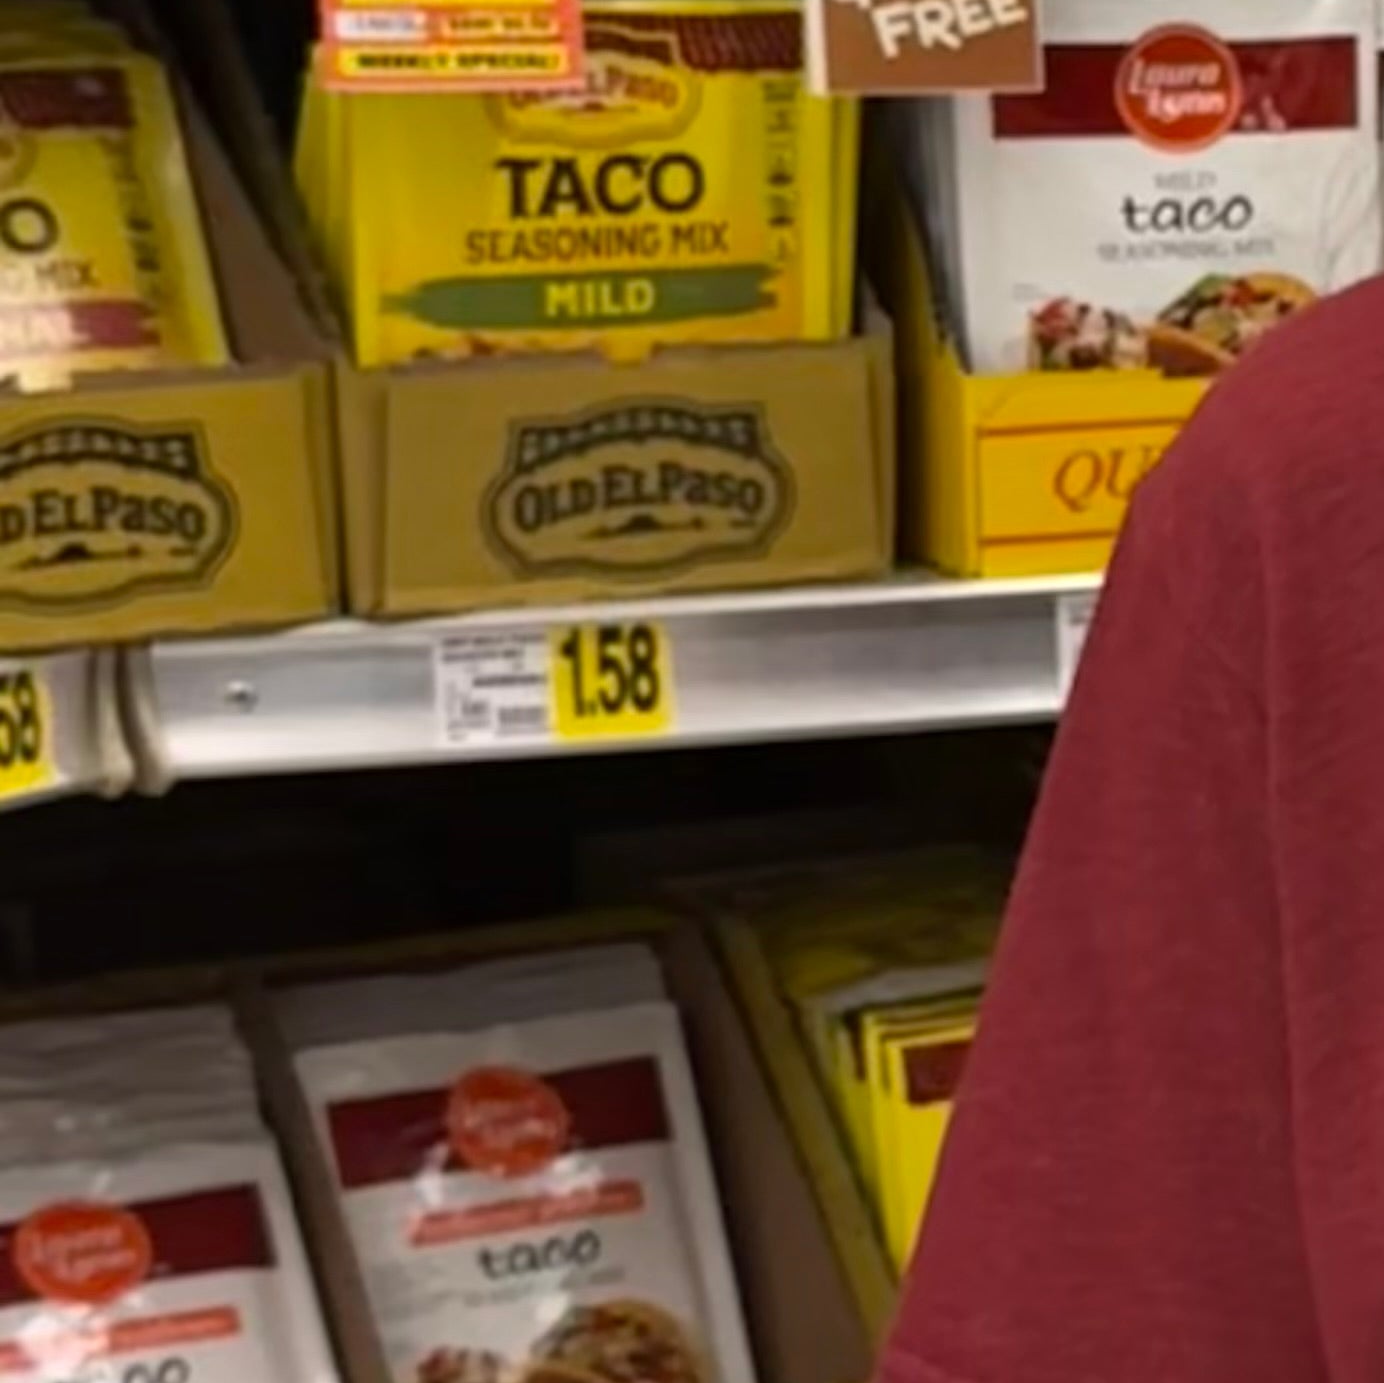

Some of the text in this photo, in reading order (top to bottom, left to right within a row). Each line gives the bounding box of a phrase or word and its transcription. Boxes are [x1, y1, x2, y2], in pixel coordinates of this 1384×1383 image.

[1129, 59, 1222, 97] Laura
[494, 153, 705, 218] TACO
[1121, 194, 1253, 233] taco
[466, 220, 729, 264] SEASONING MIX
[545, 279, 656, 318] MILD
[558, 624, 660, 716] 1.58
